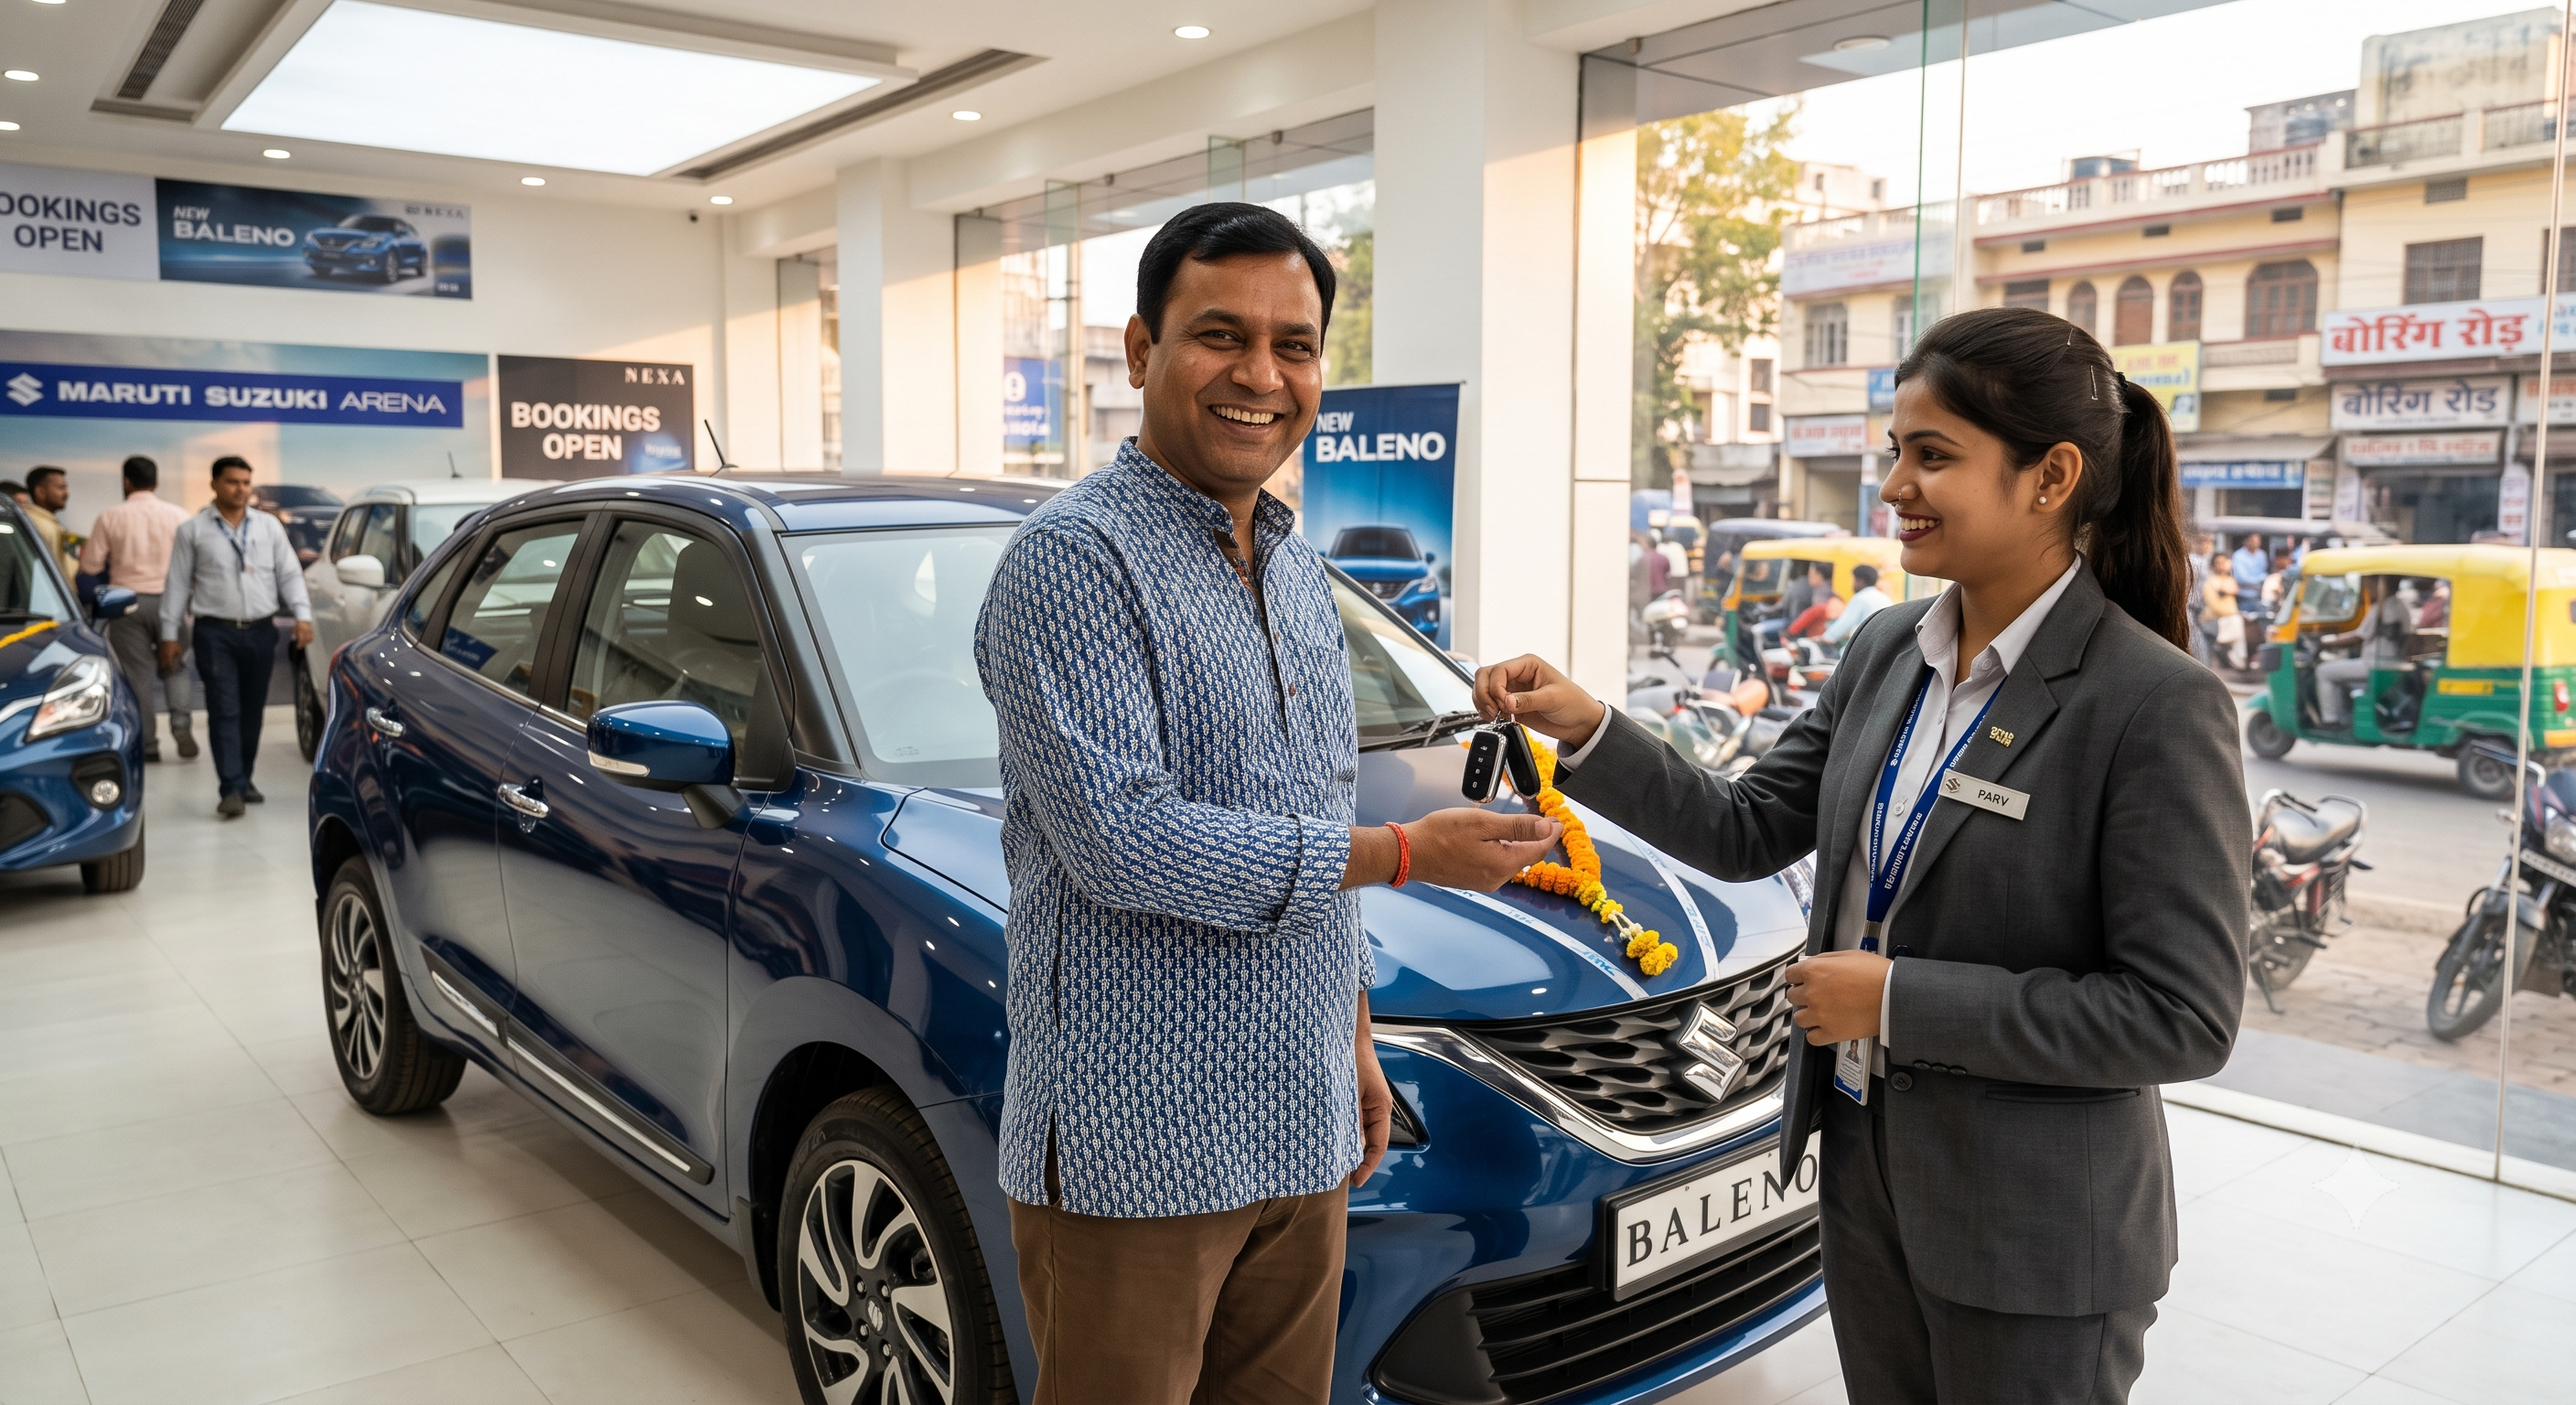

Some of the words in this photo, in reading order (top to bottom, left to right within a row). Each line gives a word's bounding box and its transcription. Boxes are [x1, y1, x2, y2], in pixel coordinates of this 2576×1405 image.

[173, 205, 209, 221] NEW
[14, 223, 103, 253] OPEN
[174, 220, 295, 247] BALENO
[2458, 308, 2528, 351] रोड़
[625, 367, 685, 385] NEXA
[58, 380, 190, 405] MARUTI
[205, 384, 327, 410] SUZUKI
[339, 391, 446, 414] ARENA
[510, 402, 660, 432] BOOKINGS
[1316, 412, 1355, 434] NEW
[542, 433, 622, 460] OPEN
[1315, 431, 1446, 463] BALENO
[1978, 789, 2009, 807] PARV
[1627, 1153, 1818, 1268] BALENO
